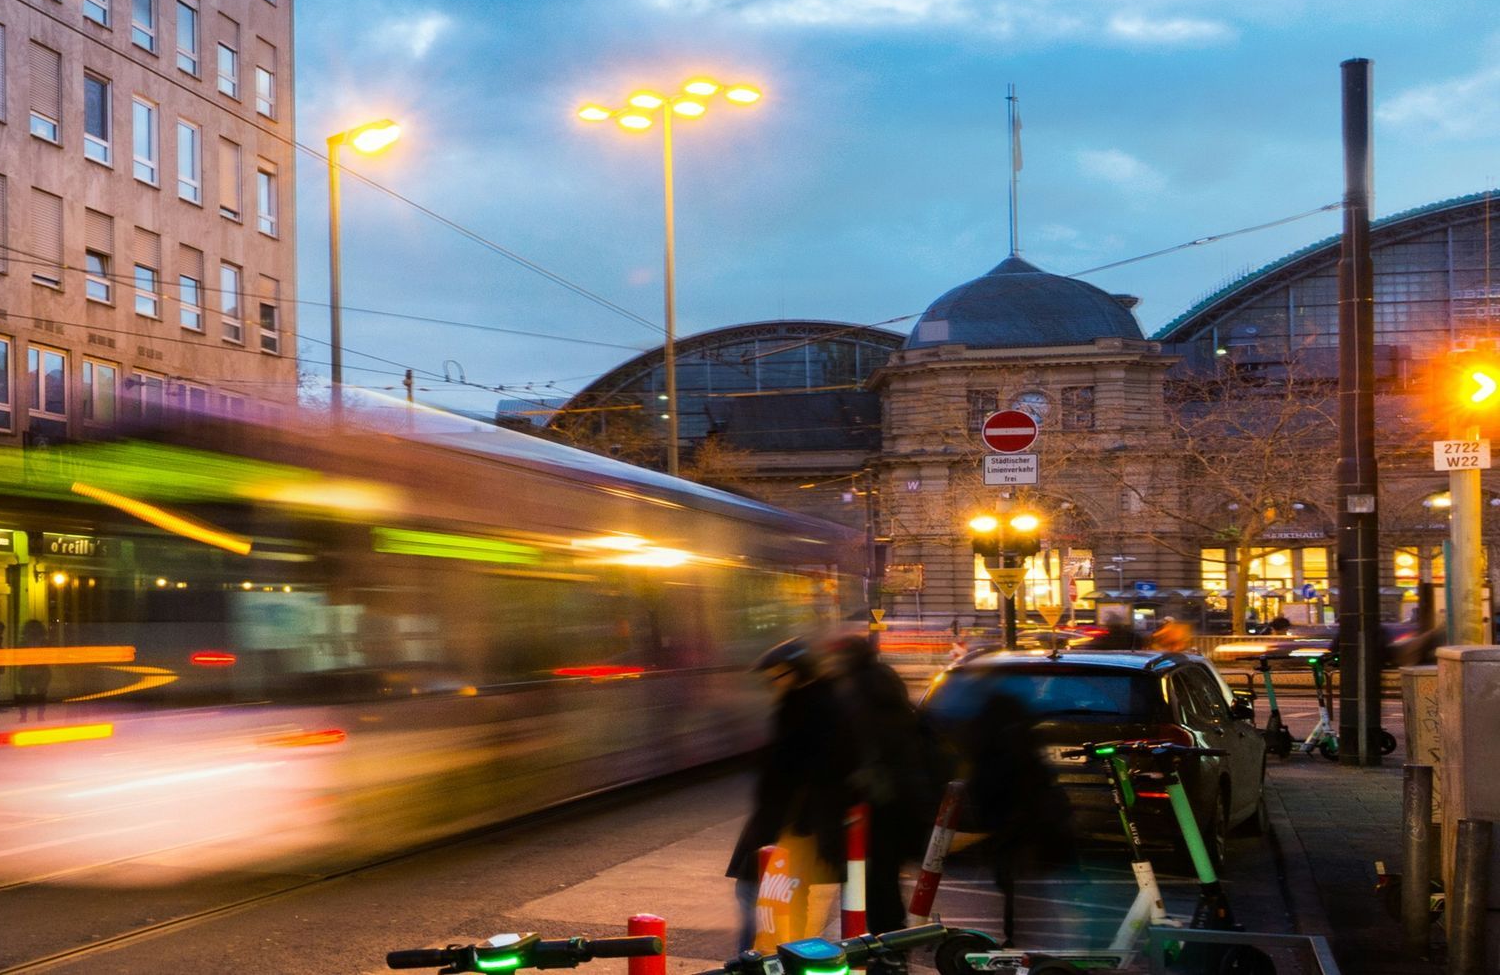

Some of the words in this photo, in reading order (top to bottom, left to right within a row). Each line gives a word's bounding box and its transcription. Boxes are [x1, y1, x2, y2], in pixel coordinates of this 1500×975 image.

[1444, 442, 1480, 454] 2722
[990, 457, 1030, 465] Städtischer
[1446, 455, 1479, 467] W22
[987, 466, 1035, 474] Linienverkehr
